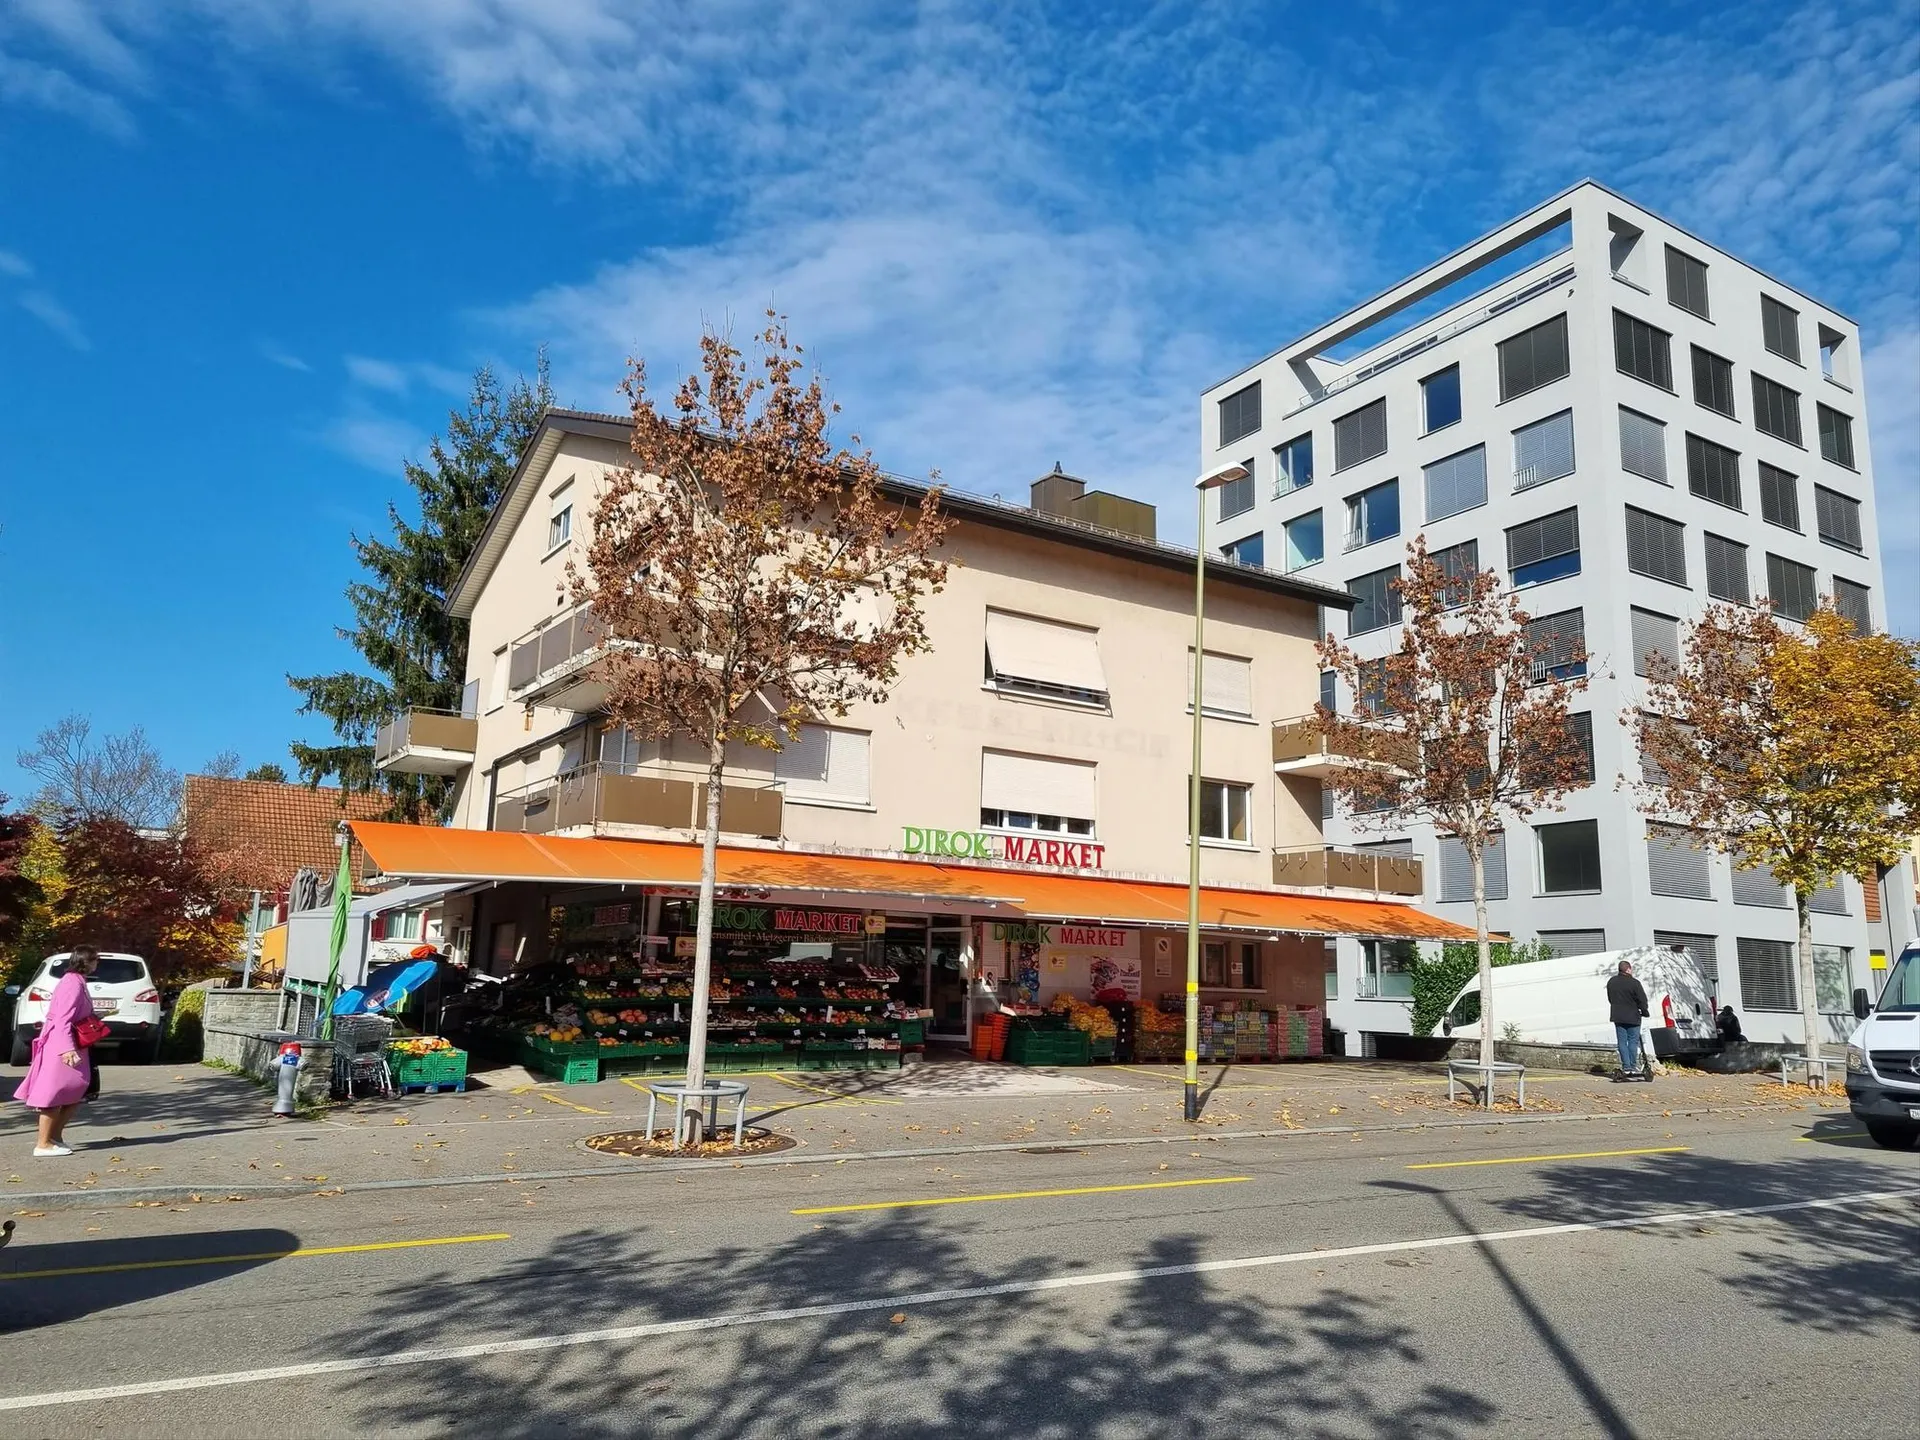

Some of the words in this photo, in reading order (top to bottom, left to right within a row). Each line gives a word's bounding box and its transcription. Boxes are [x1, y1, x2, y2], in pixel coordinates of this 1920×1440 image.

[903, 826, 991, 860] DIROK
[1004, 836, 1105, 868] MARKET
[689, 904, 767, 930] ROK
[775, 910, 861, 934] MARKET
[994, 923, 1052, 944] DIROK
[1061, 927, 1126, 947] MARKET
